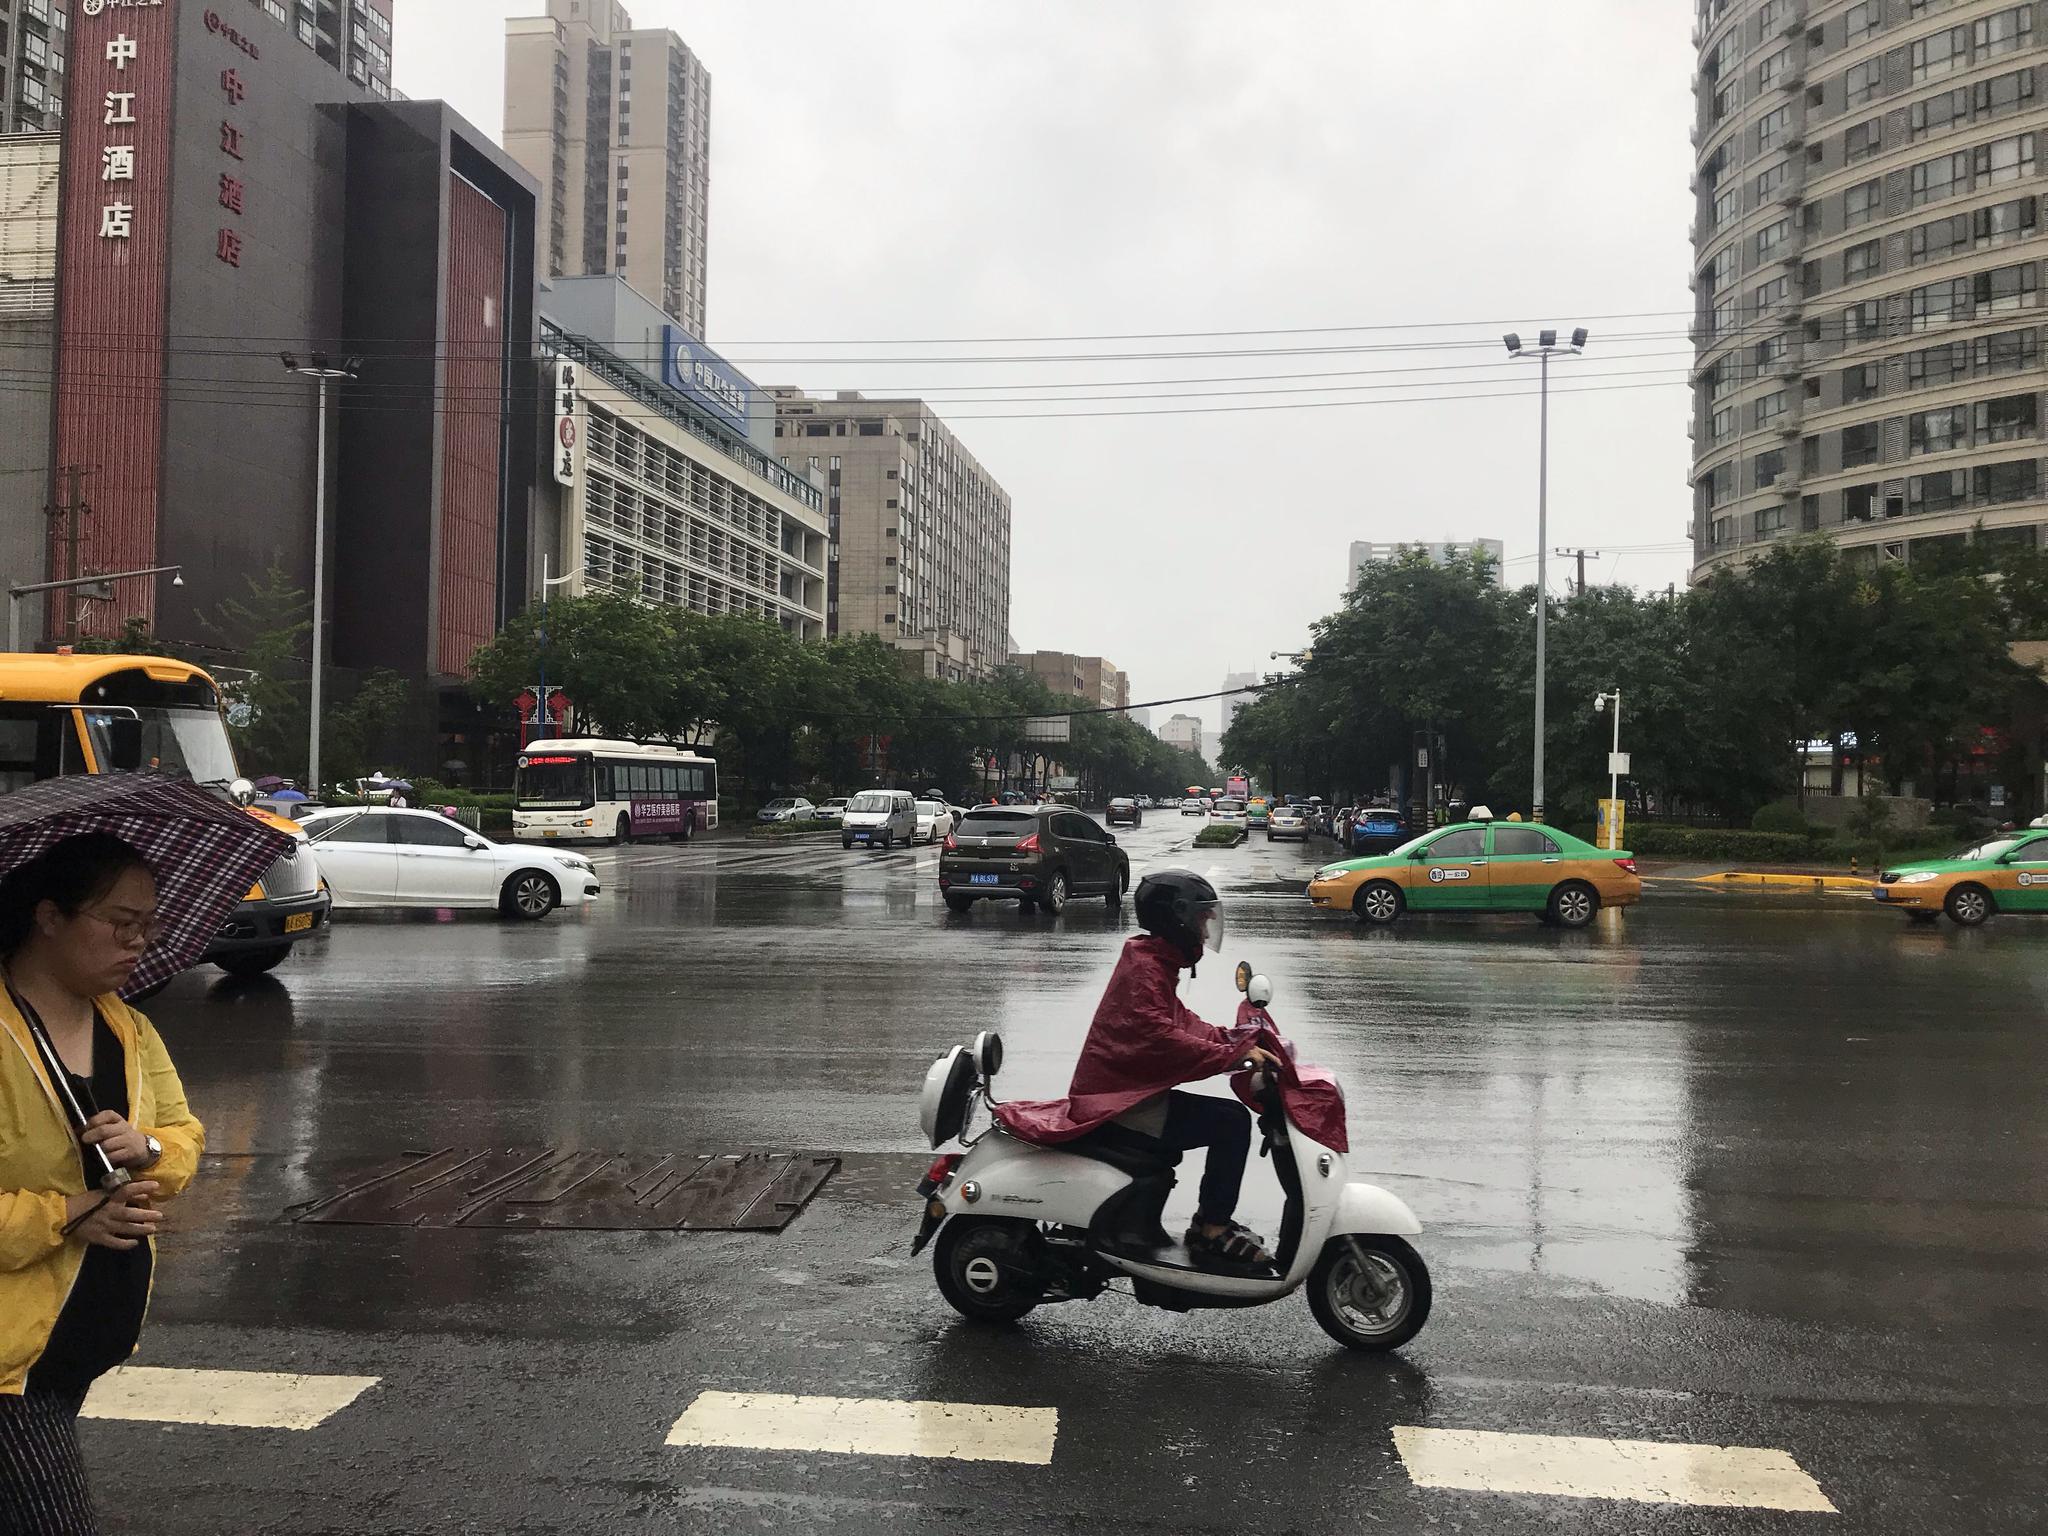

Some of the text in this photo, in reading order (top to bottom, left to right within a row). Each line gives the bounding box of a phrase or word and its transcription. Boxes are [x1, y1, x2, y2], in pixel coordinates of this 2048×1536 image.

[99, 33, 138, 239] 中江酒店
[216, 68, 244, 268] 中江酒店
[641, 803, 680, 817] 华艺医疗美容医院
